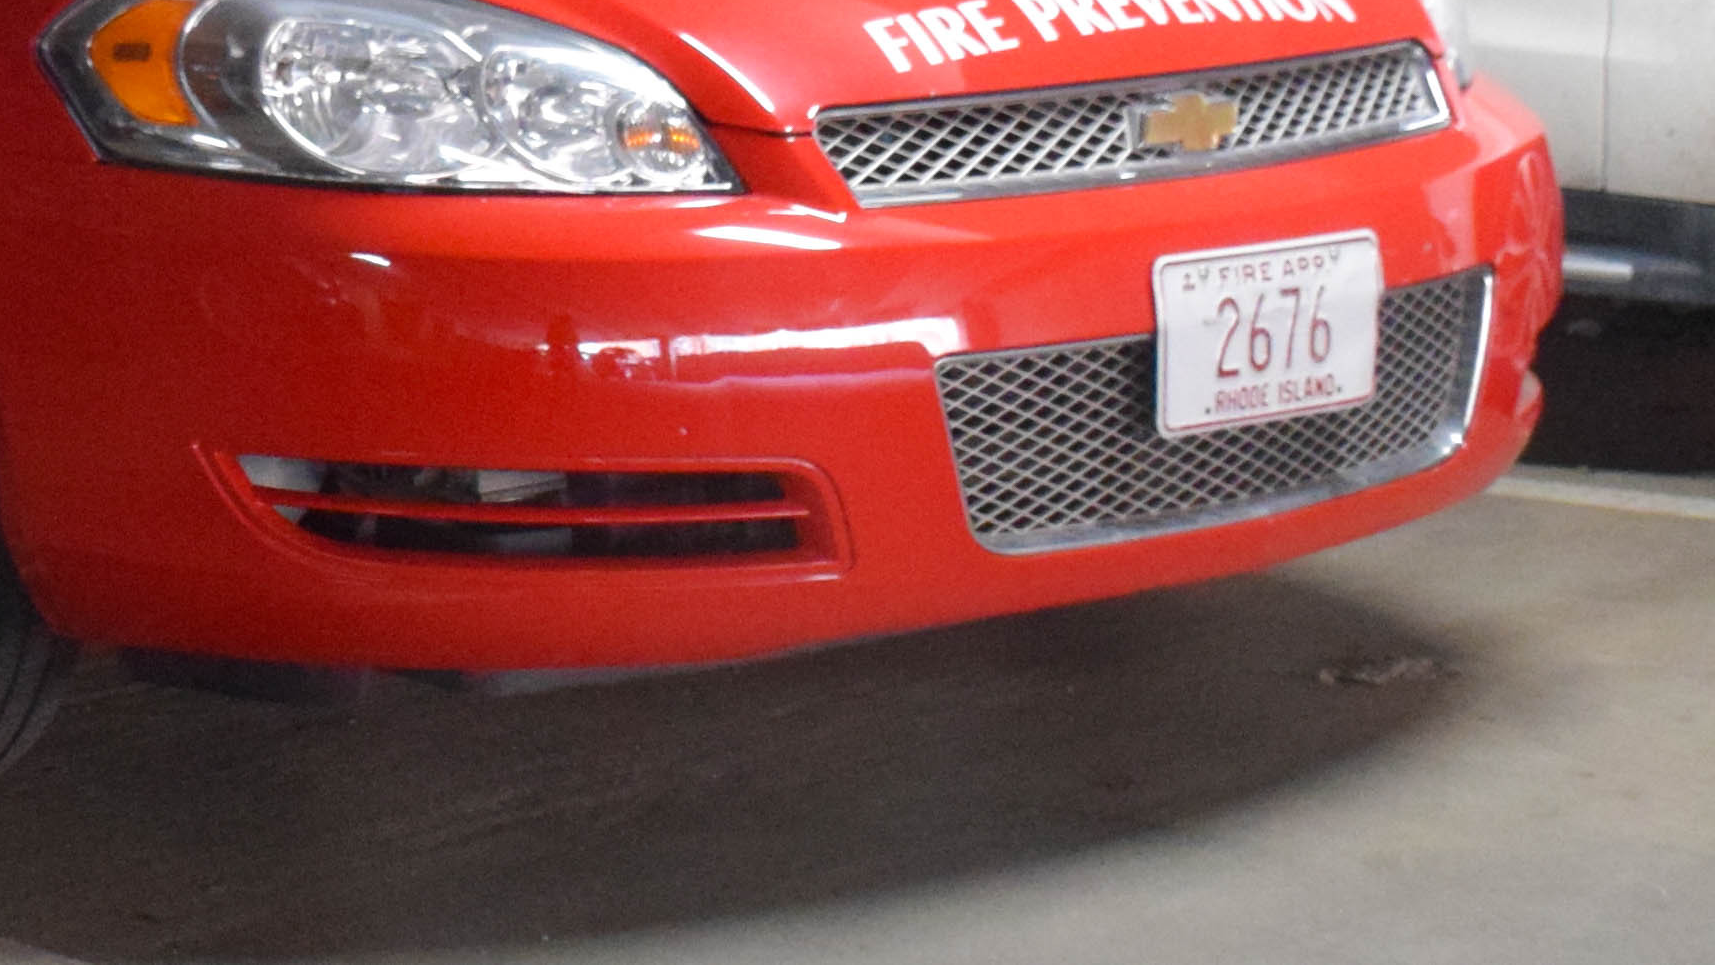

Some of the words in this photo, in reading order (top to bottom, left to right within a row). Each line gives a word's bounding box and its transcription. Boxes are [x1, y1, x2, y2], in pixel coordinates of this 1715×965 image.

[1218, 260, 1273, 286] FIRE
[1216, 284, 1332, 379] 2676
[1214, 382, 1270, 414] RHODE
[1277, 373, 1336, 405] ISLAND
